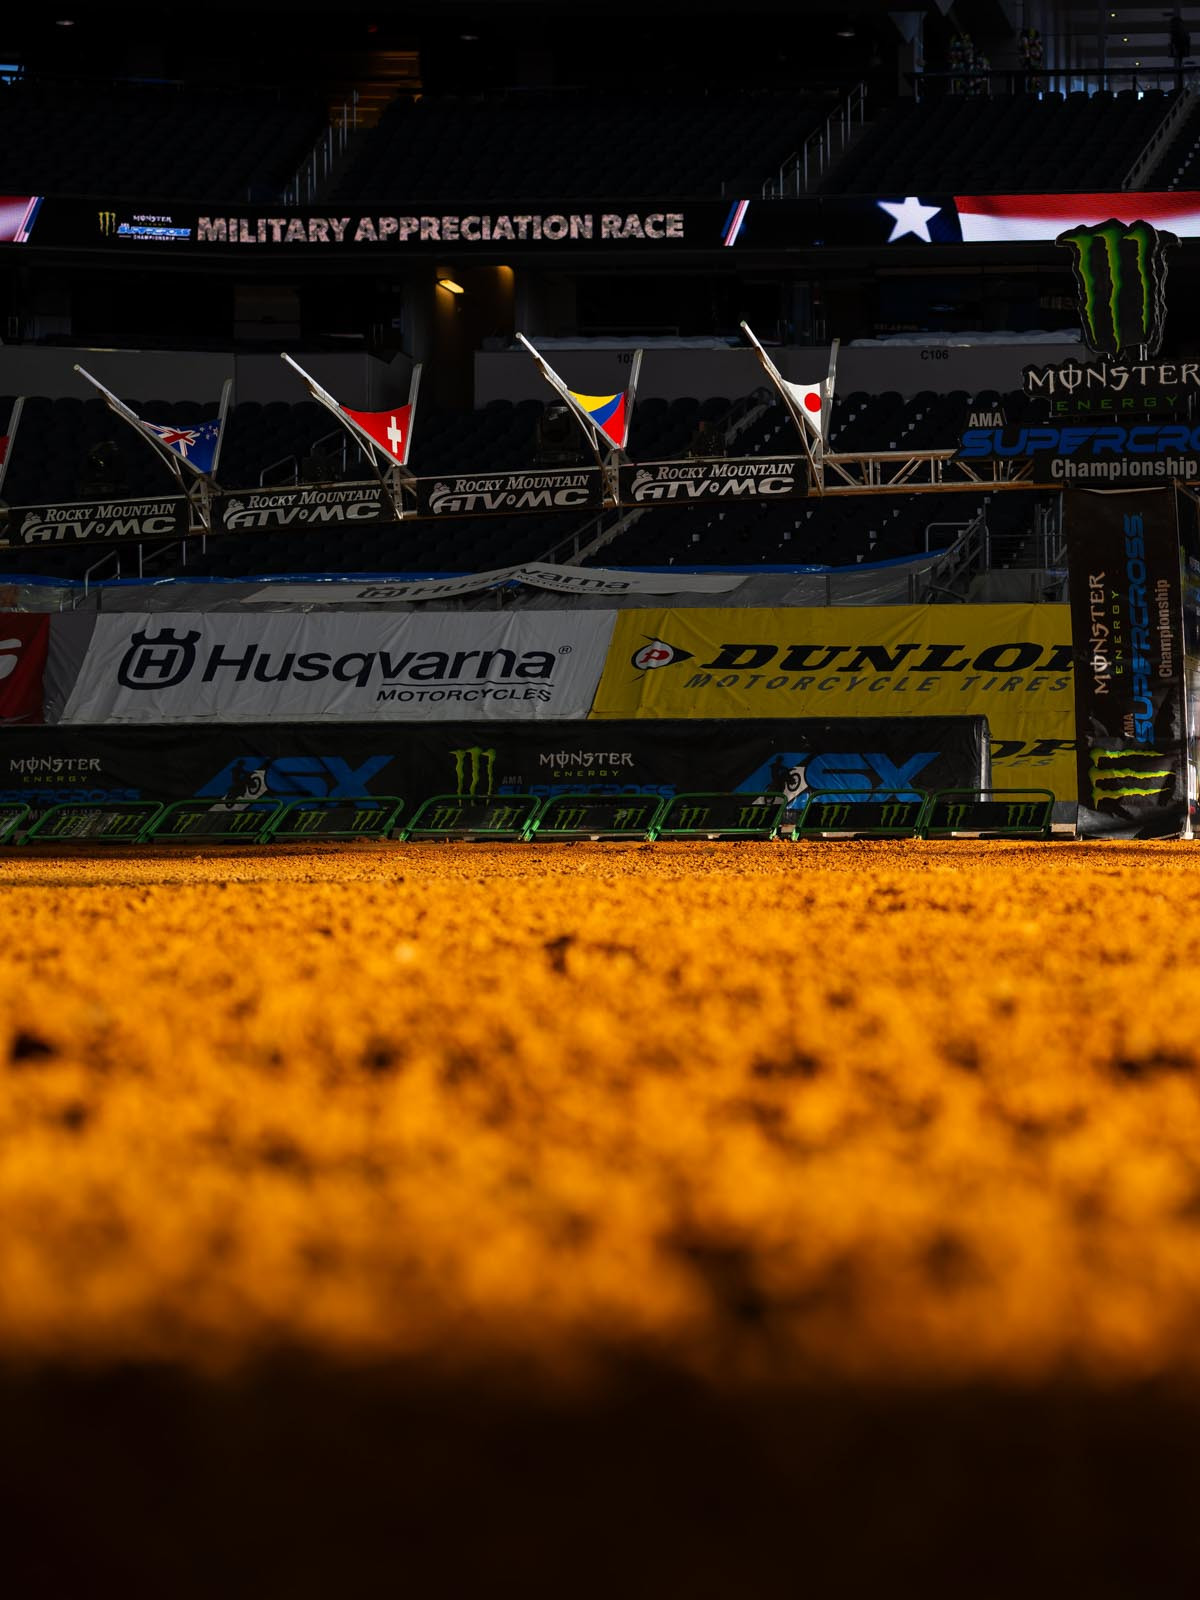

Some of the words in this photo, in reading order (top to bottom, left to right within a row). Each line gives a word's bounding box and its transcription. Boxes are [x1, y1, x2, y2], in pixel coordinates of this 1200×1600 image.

[197, 215, 350, 243] MILITARY
[354, 213, 593, 242] APPRECIATION
[600, 212, 685, 240] RACE
[920, 349, 950, 361] C106
[1055, 395, 1180, 412] ENERGY
[968, 411, 1004, 428] AMA
[656, 465, 707, 480] ROCKY
[710, 463, 795, 477] MOUNTAIN
[1050, 456, 1199, 481] Championship
[453, 478, 504, 493] ROCKY
[506, 474, 590, 490] MOUNTAIN
[247, 494, 297, 509] ROCKY
[299, 489, 382, 504] MOUNTAIN
[45, 508, 93, 522] ROCKY
[95, 503, 176, 519] MOUNTAIN
[1088, 571, 1110, 696] MONSTER
[1111, 589, 1124, 676] ENERGY
[1123, 511, 1156, 745] SUPERCROSS
[1158, 578, 1172, 679] Championship
[684, 672, 946, 693] MOTORCYCLE
[960, 675, 1073, 692] TIRES
[377, 687, 553, 703] MOTORCYCLES
[1123, 711, 1136, 738] AMA
[10, 756, 103, 774] MONSTER
[538, 750, 635, 769] MONSTER
[23, 775, 89, 783] ENERGY
[502, 775, 524, 785] AMA
[553, 769, 619, 777] ENERGY
